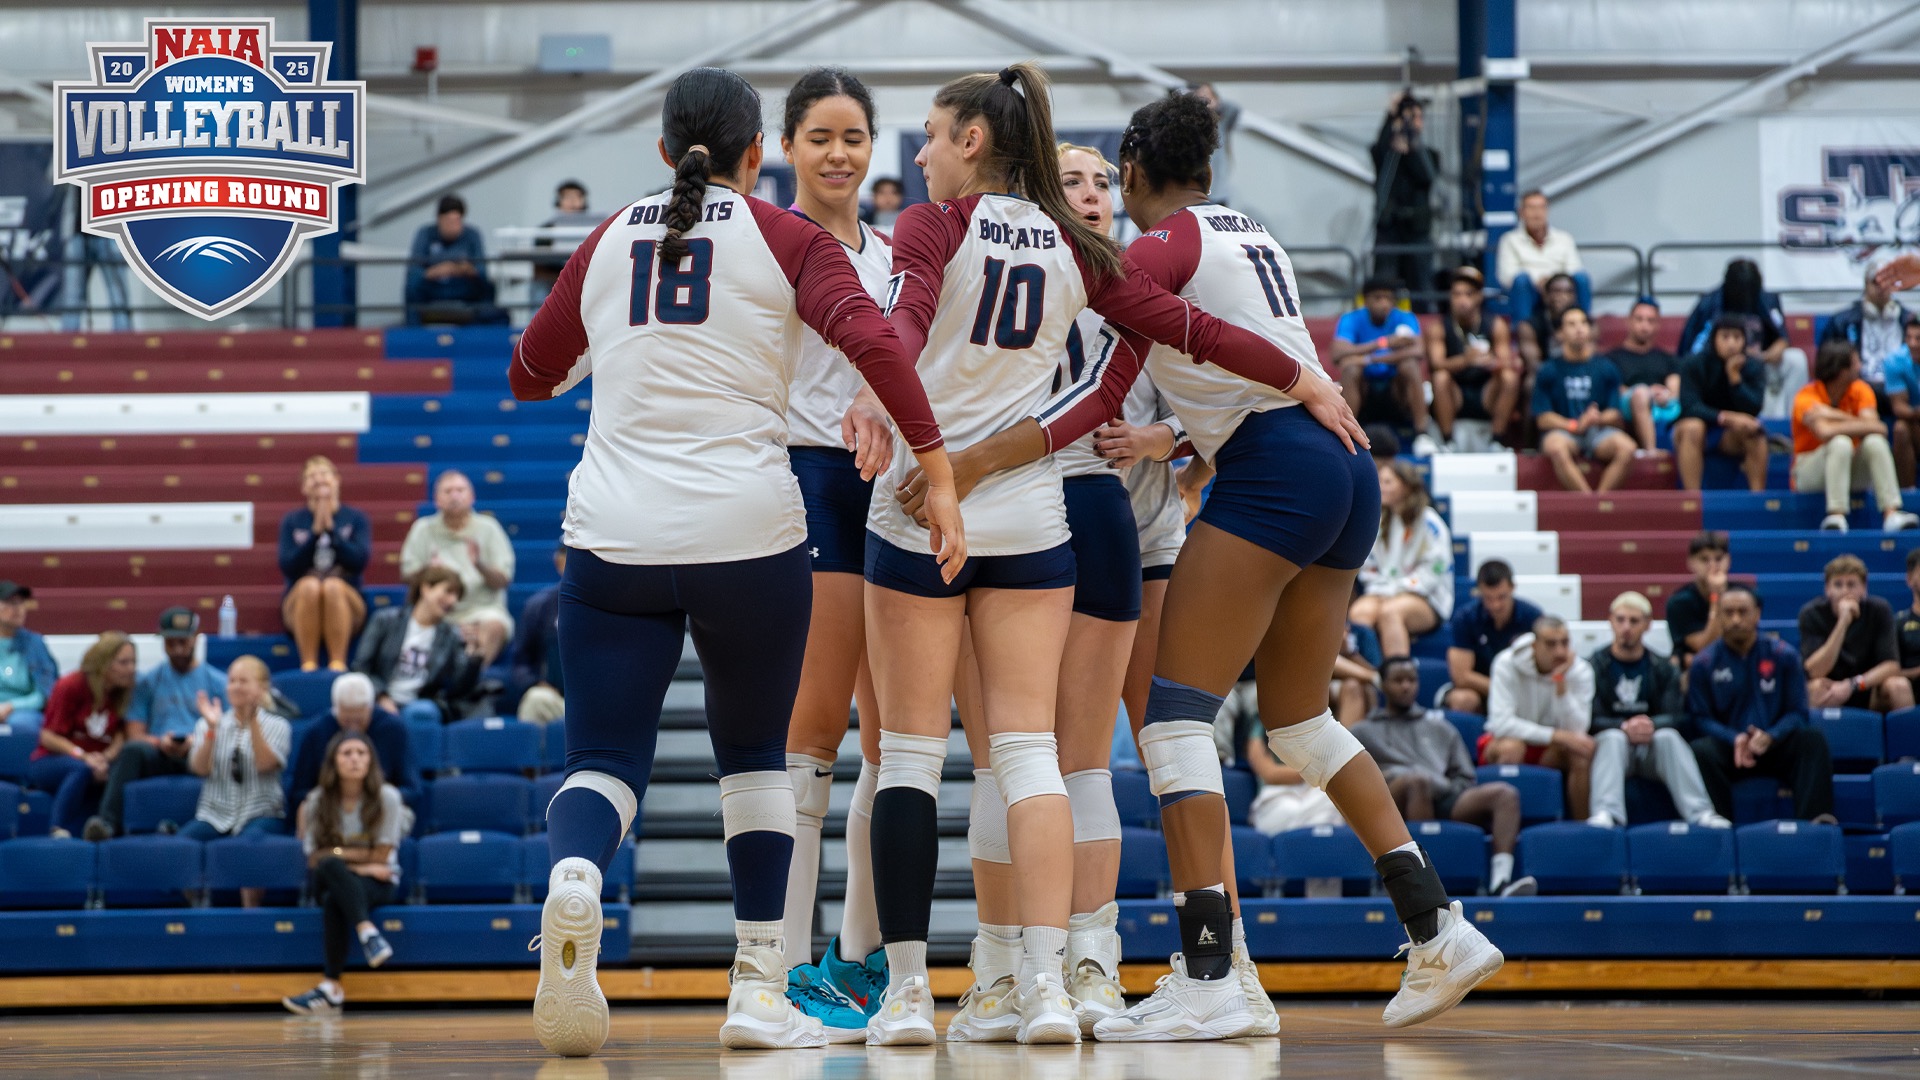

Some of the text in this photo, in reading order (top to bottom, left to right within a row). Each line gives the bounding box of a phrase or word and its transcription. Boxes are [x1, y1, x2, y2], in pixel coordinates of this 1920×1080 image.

[629, 237, 714, 327] 18
[969, 255, 1046, 350] 10
[1240, 243, 1298, 318] 11
